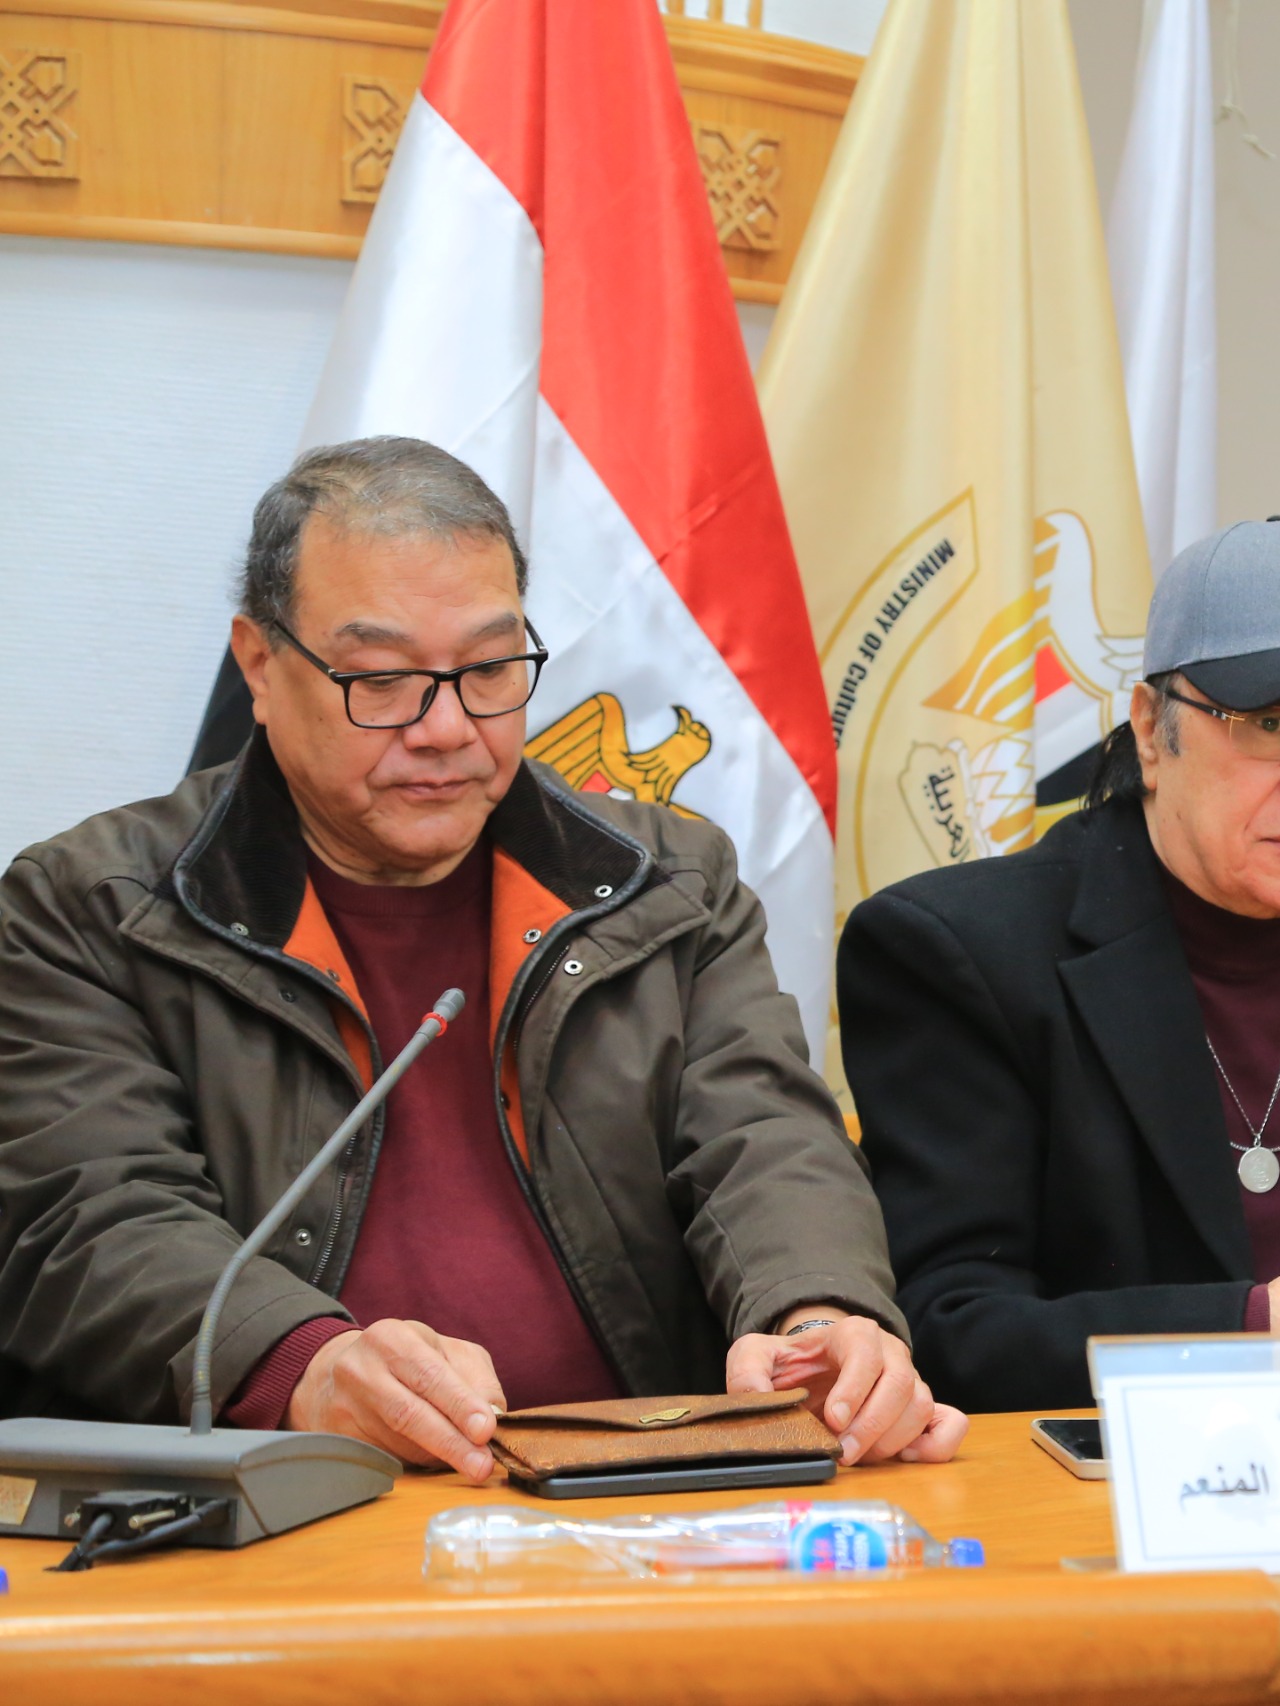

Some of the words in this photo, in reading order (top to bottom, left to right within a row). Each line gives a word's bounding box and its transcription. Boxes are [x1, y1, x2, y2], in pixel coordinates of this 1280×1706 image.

[874, 537, 955, 634] MINISTRY
[858, 631, 882, 663] OF
[1179, 1461, 1269, 1514] المنعم
